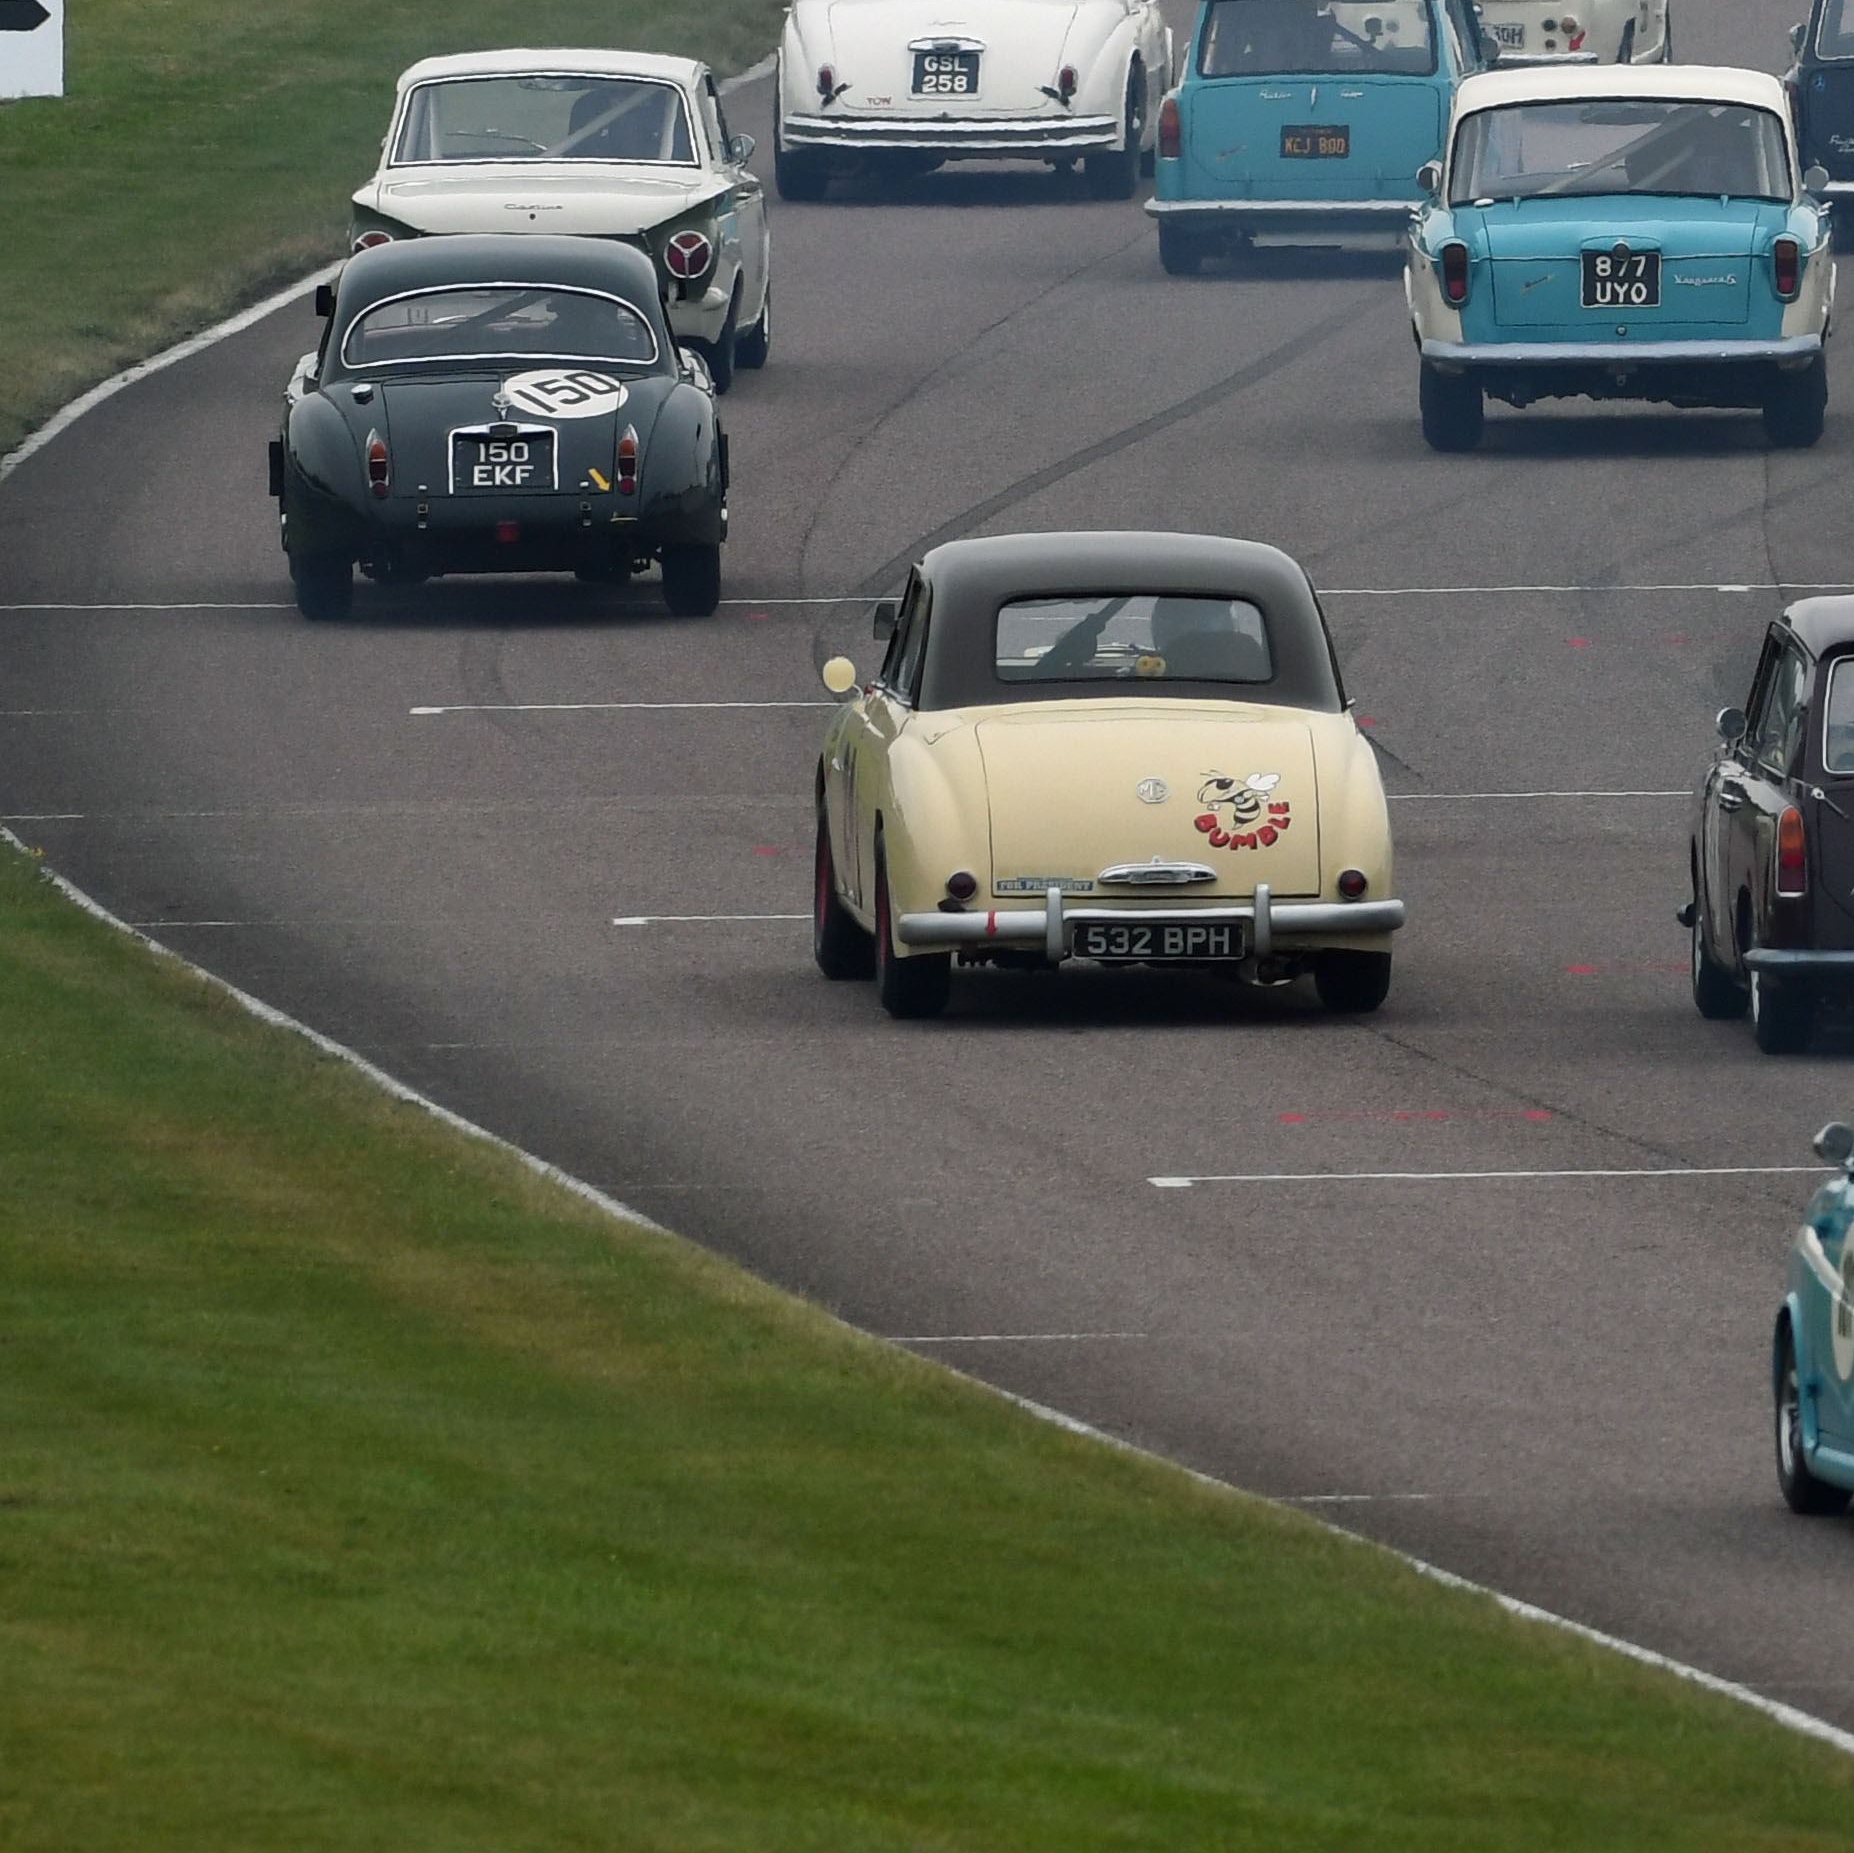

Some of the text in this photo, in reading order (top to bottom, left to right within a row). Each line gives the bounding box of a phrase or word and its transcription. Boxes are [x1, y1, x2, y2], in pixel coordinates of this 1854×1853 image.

[923, 55, 969, 72] GSL
[922, 75, 968, 93] 258
[1594, 255, 1648, 279] 877
[1594, 280, 1649, 304] UYO
[514, 370, 622, 415] 150
[478, 441, 530, 463] 150
[472, 464, 534, 486] EKF
[1194, 800, 1290, 851] BUMBLE
[1087, 926, 1232, 956] 532 BPH
